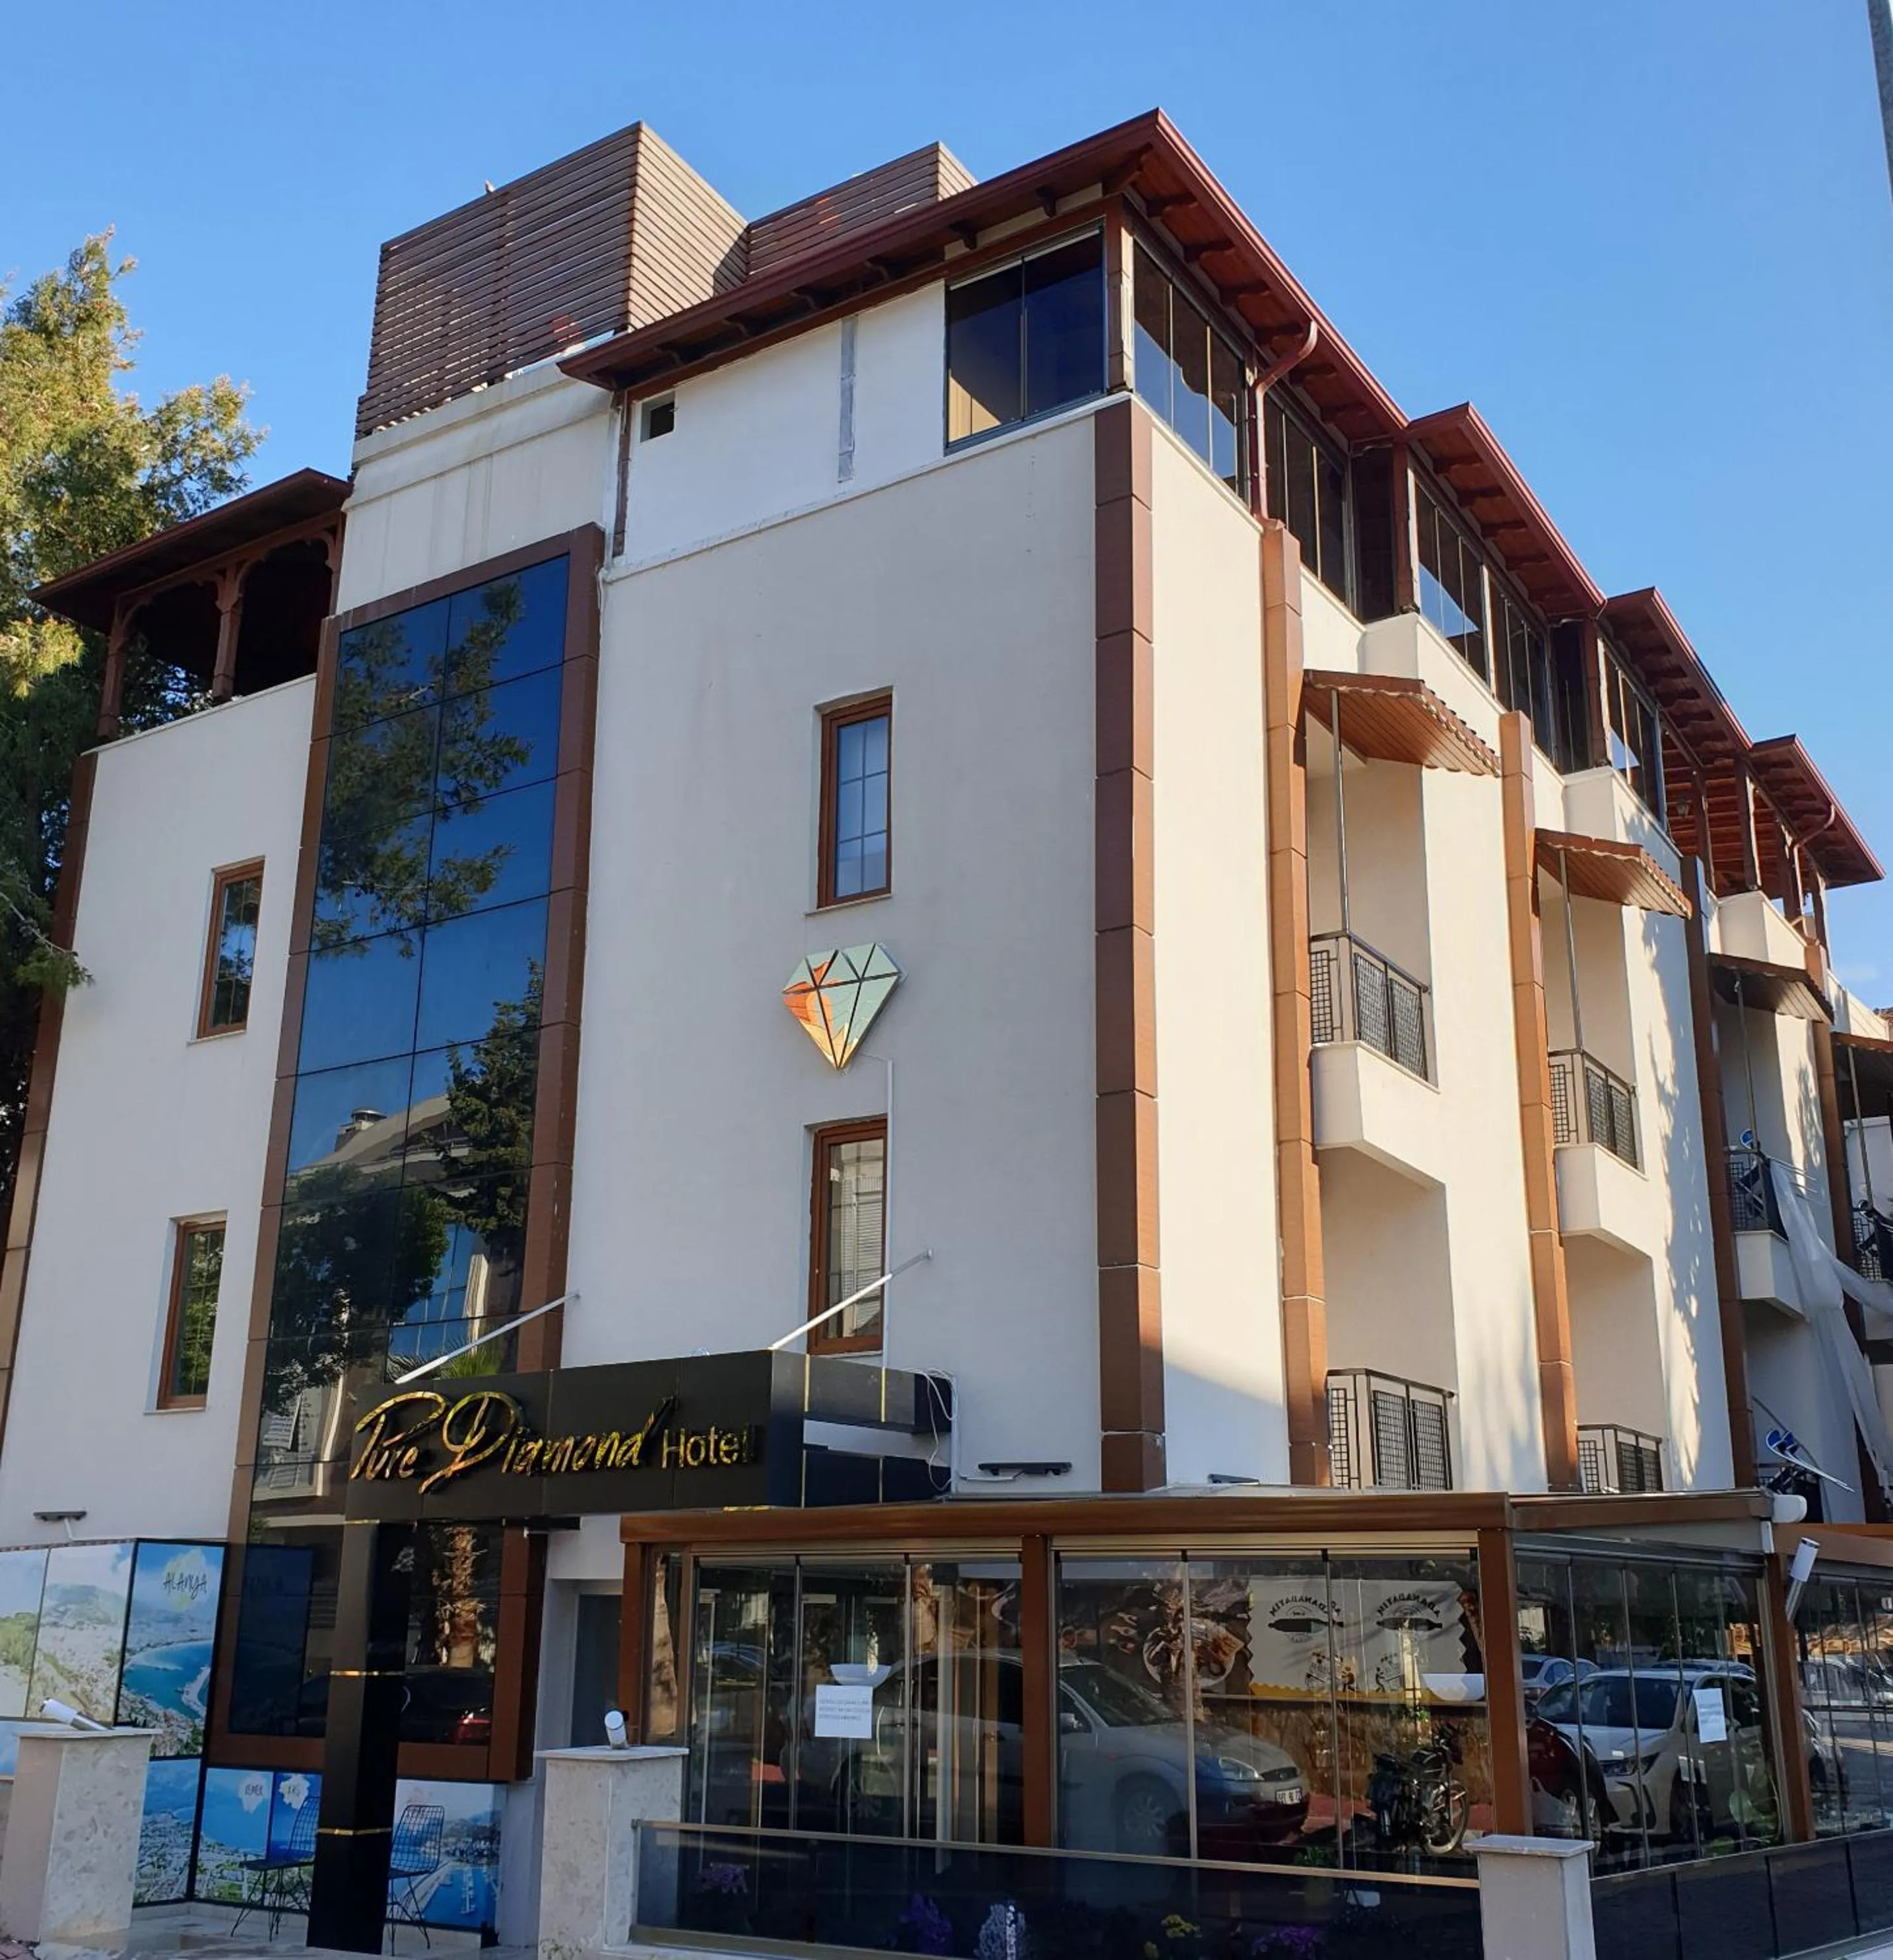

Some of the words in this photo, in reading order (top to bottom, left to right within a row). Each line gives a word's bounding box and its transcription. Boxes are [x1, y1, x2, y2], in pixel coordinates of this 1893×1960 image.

[350, 1391, 446, 1480] Pure
[418, 1391, 677, 1495] Diamond
[661, 1424, 750, 1469] Hotel
